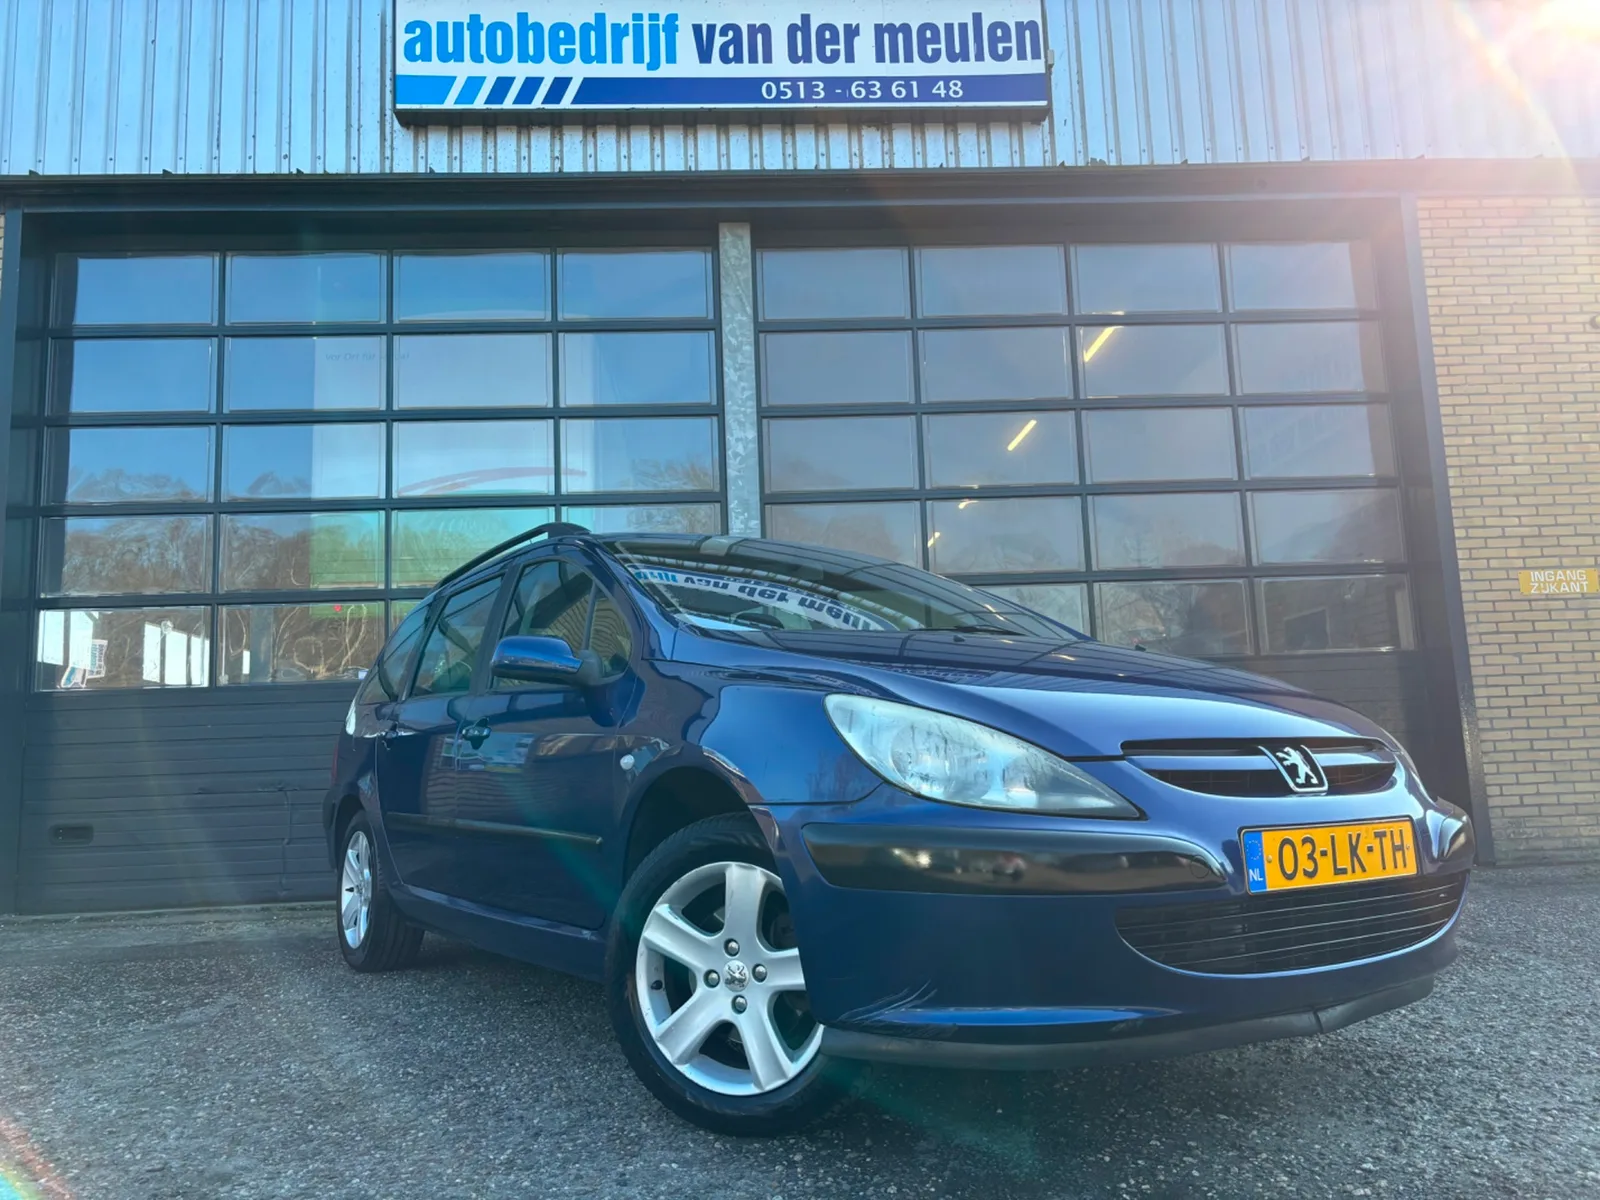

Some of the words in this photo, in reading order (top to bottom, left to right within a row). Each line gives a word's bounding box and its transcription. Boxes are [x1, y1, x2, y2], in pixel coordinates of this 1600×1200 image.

[403, 12, 679, 71] autobedrijf
[691, 23, 773, 65] van
[787, 13, 860, 65] der
[873, 12, 1043, 64] meulen
[761, 81, 825, 100] 0513
[850, 80, 882, 99] 63
[891, 80, 919, 99] 61
[931, 79, 964, 98] 48
[1530, 569, 1587, 582] INGANG
[1277, 828, 1408, 880] 03-LK-TH
[1248, 868, 1264, 882] NL
